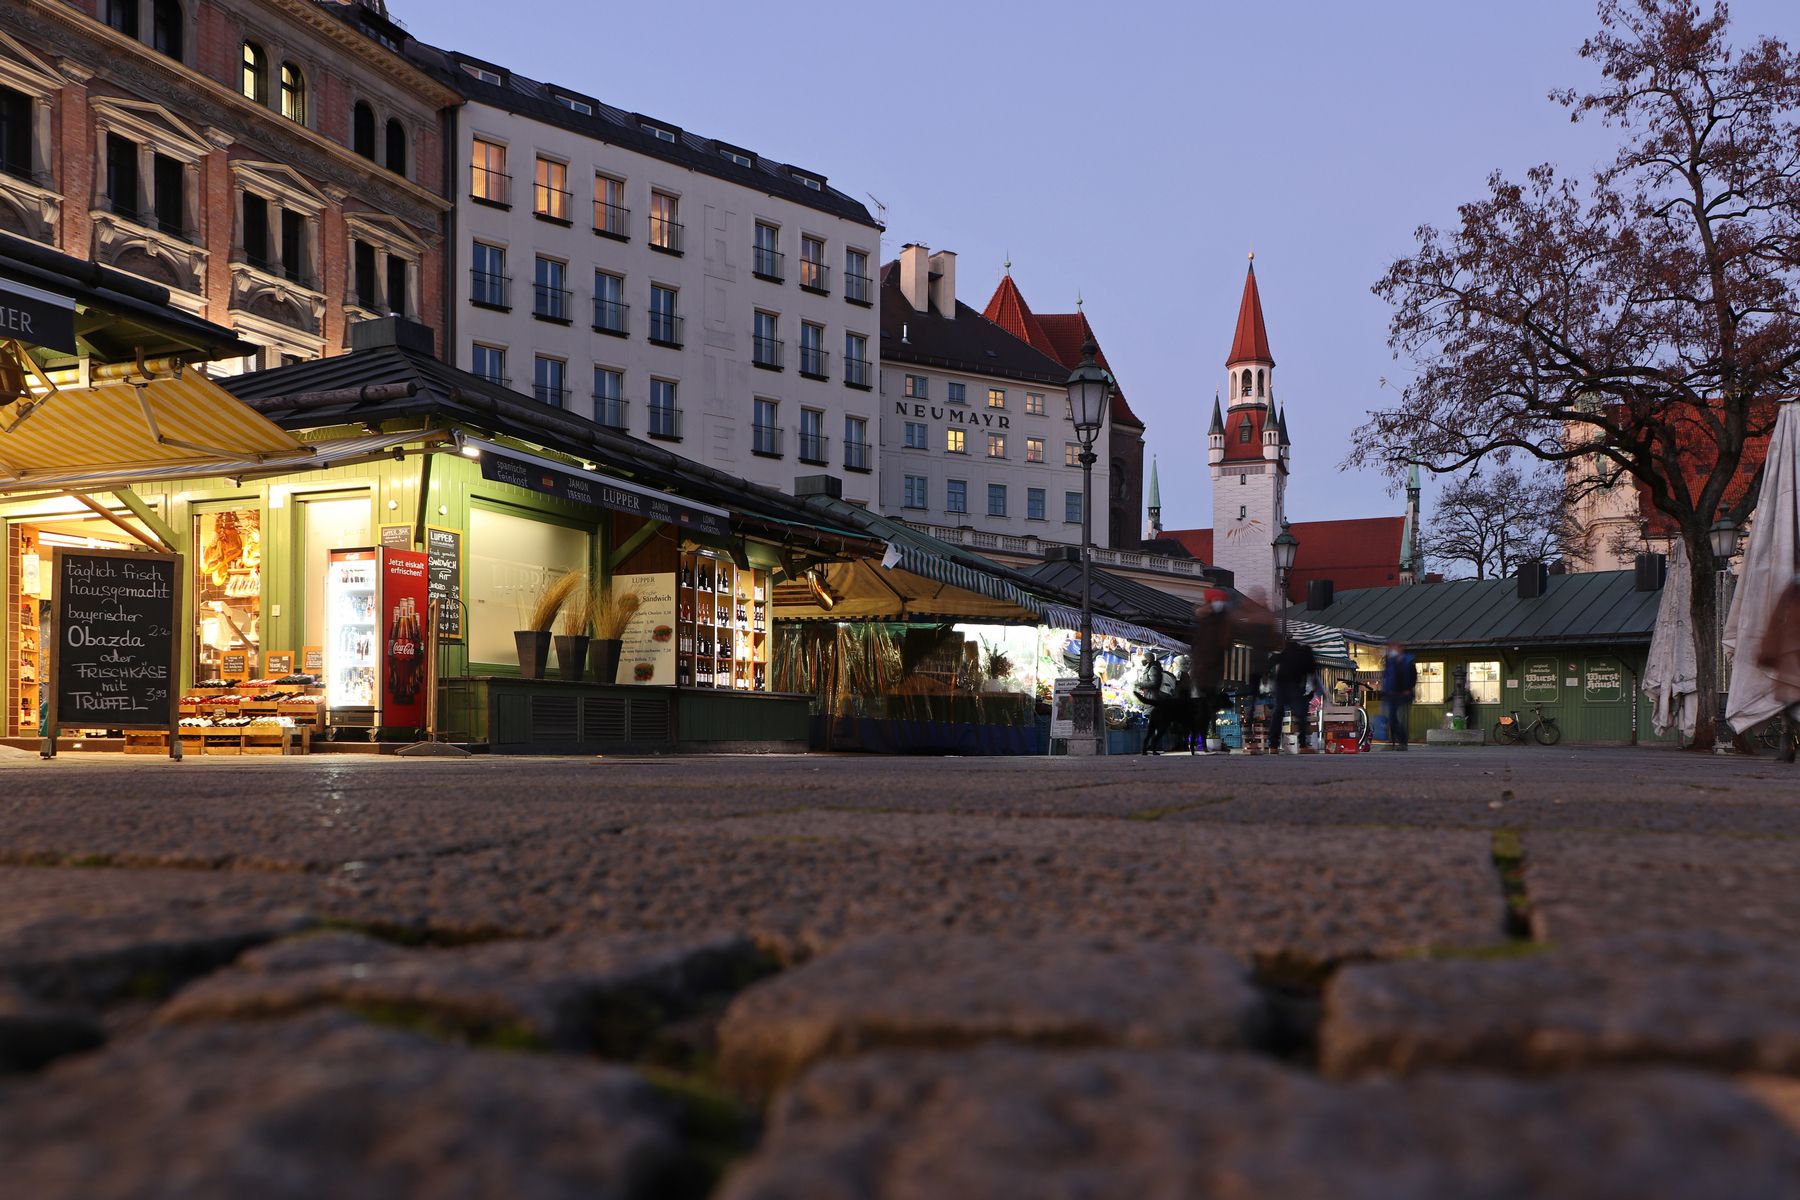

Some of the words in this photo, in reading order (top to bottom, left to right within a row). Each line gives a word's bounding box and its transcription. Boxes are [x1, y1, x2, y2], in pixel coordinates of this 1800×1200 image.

[896, 402, 1010, 428] NEUMAYR
[497, 461, 527, 475] spanische
[497, 470, 528, 487] Feinkost
[603, 489, 640, 509] LUPPER
[430, 531, 454, 543] LUPPER
[66, 559, 117, 583] täglich
[122, 564, 164, 581] frisch
[388, 558, 404, 567] Jetzt
[405, 559, 424, 569] eiskalt
[390, 567, 422, 577] erfrischen!
[70, 578, 170, 604] hausgemacht
[642, 594, 672, 602] Sandwich
[68, 604, 143, 624] bayerischer
[68, 625, 145, 647] Obazda
[100, 649, 136, 663] oder
[72, 662, 167, 678] FRISCHKÄSE
[102, 680, 128, 691] mit
[68, 692, 148, 710] TRÜFFEL
